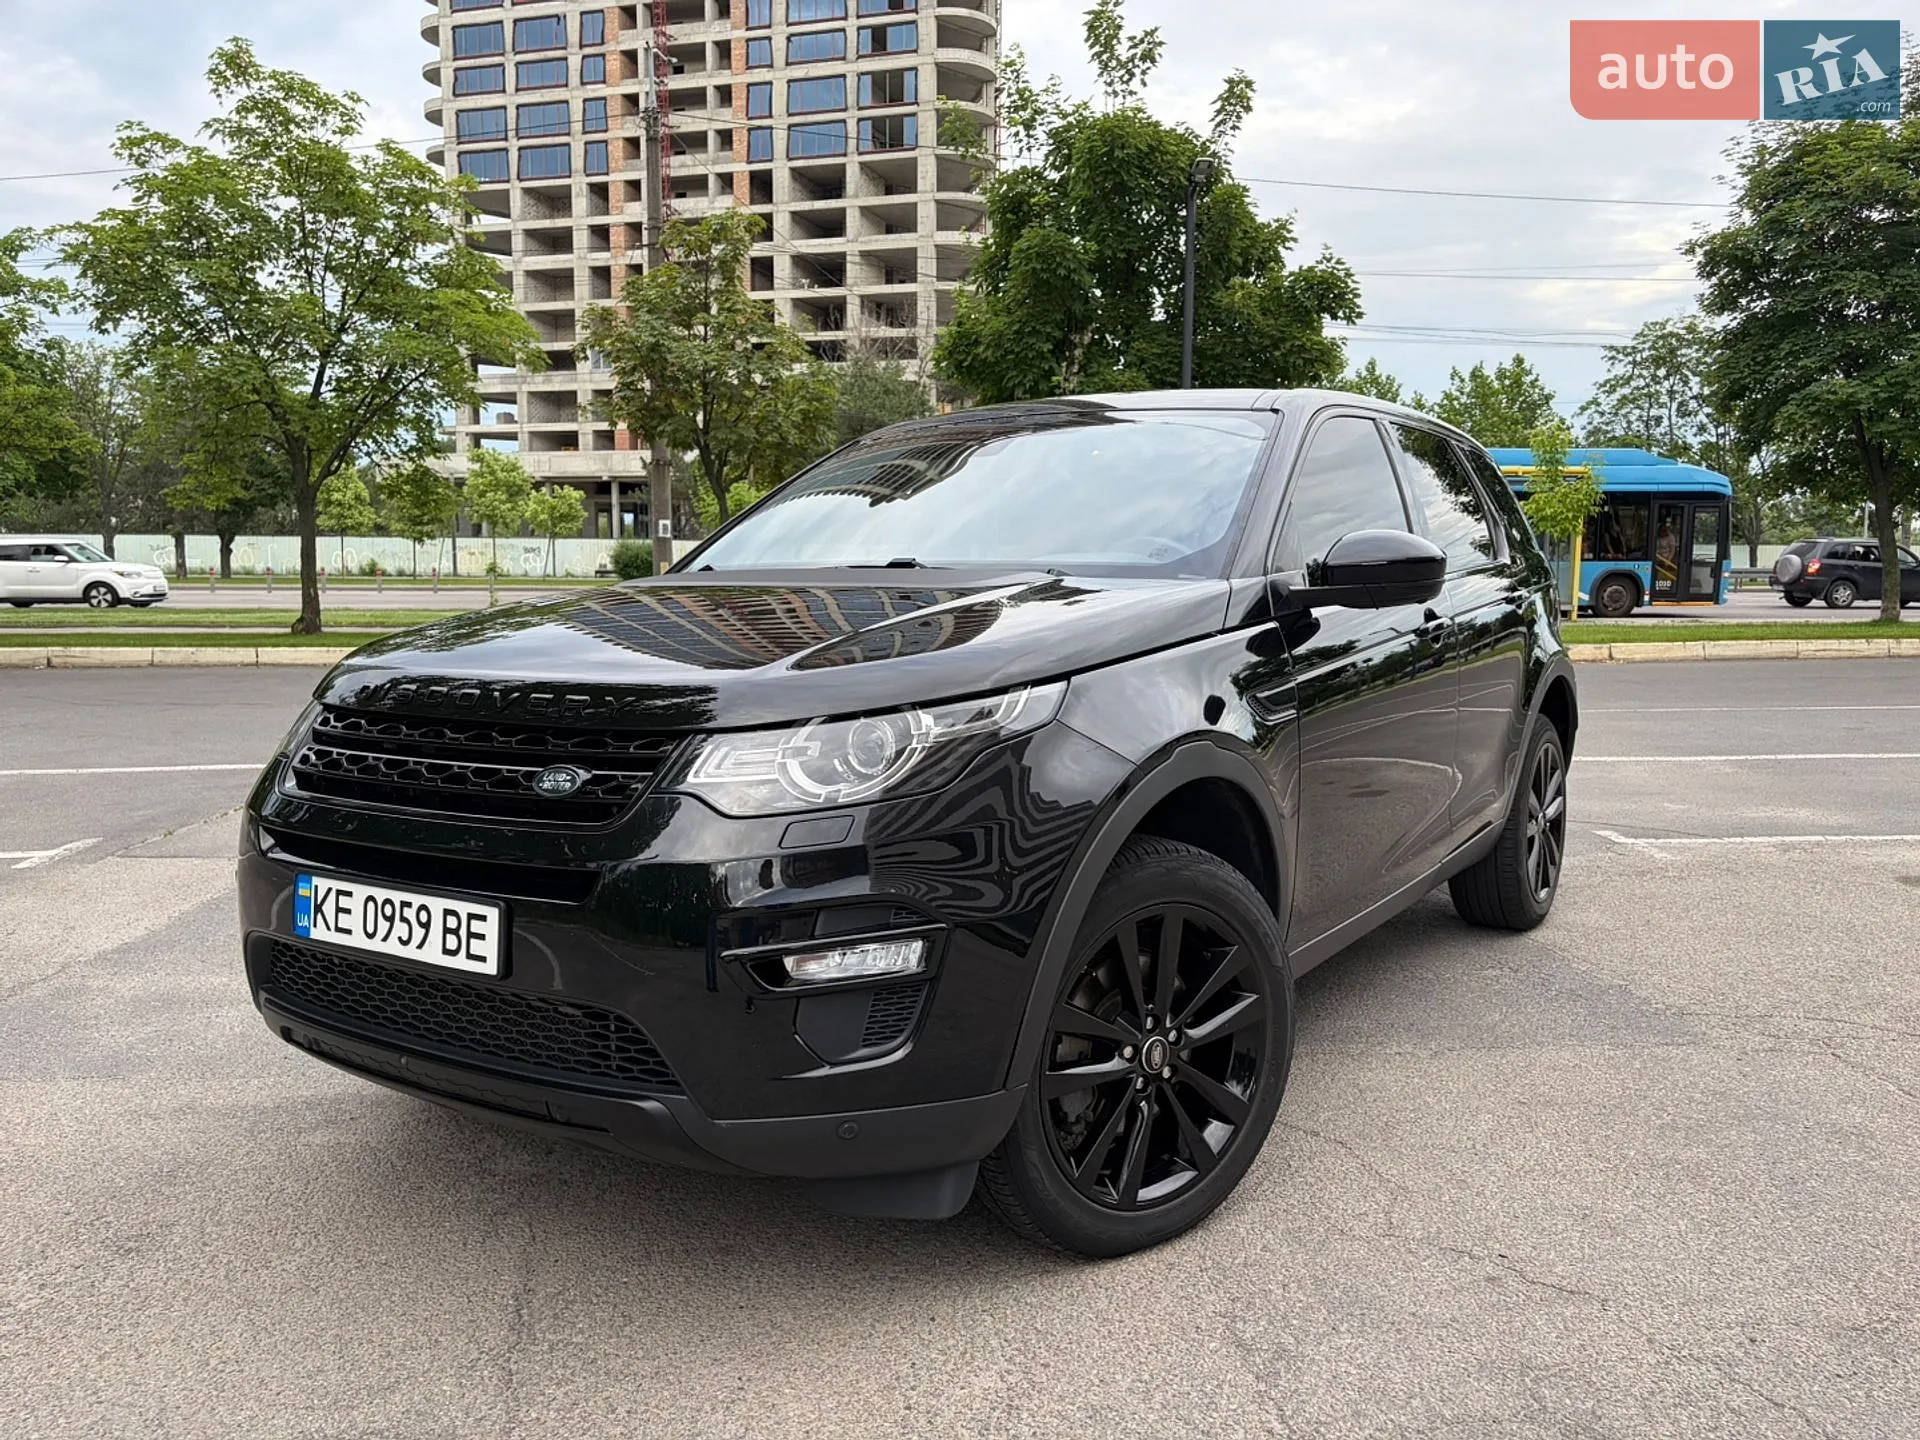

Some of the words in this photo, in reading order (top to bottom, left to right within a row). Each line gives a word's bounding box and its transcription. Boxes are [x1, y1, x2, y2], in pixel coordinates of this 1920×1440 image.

[297, 912, 310, 928] UA
[313, 884, 353, 936] KE
[363, 894, 432, 949] 0959
[441, 907, 488, 963] BE
